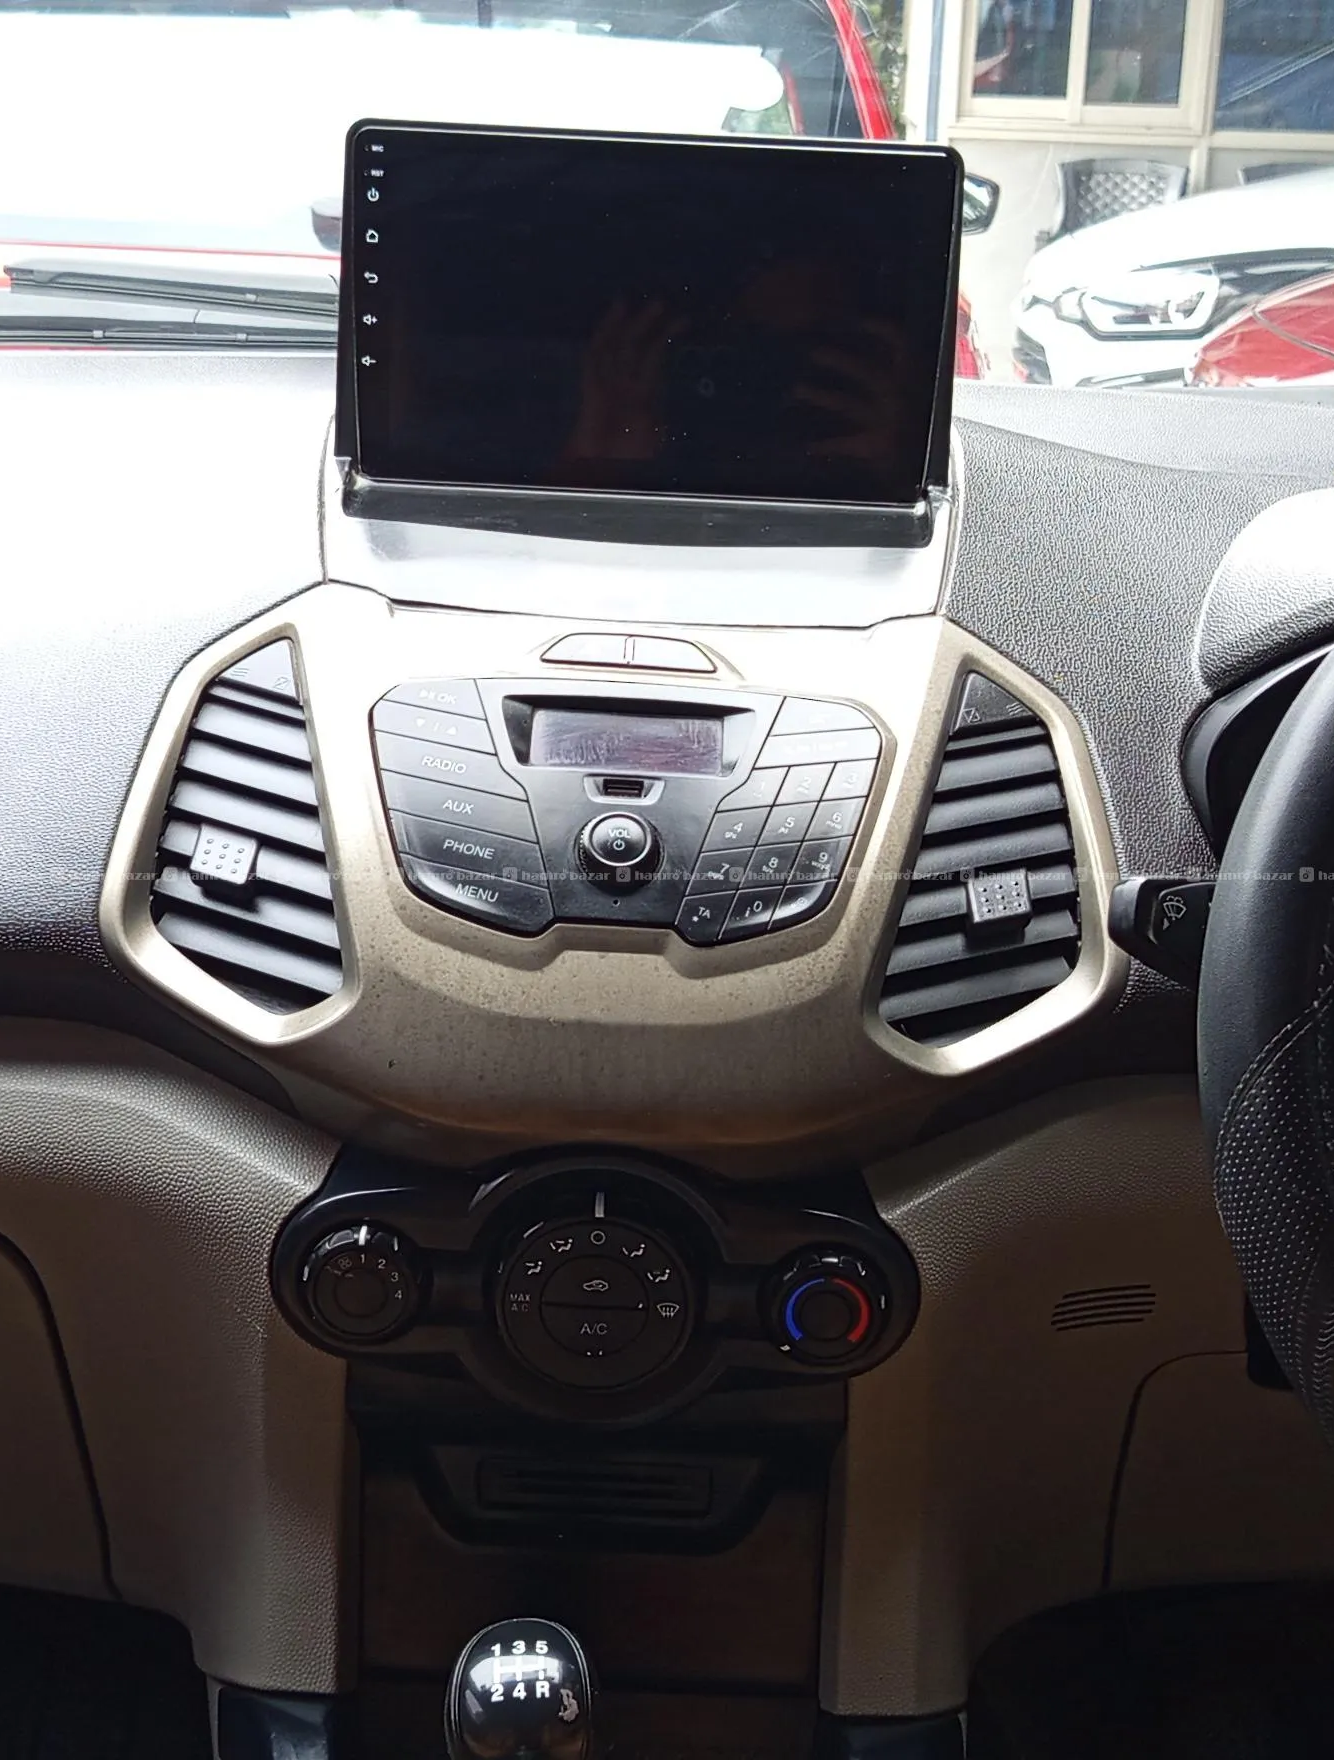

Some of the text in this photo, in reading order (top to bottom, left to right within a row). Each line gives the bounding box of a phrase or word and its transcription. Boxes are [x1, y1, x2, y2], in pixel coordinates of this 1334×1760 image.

[436, 691, 457, 705] OK
[421, 755, 467, 774] RADIO
[442, 799, 474, 815] AUX
[784, 816, 796, 828] 5
[832, 812, 842, 823] 6
[608, 829, 631, 839] VOL
[733, 822, 743, 834] 4
[443, 839, 496, 860] PHONE
[768, 857, 779, 869] 8
[818, 851, 828, 863] 9
[720, 862, 730, 874] 7
[454, 883, 499, 903] MENU
[699, 906, 711, 919] TA
[753, 900, 763, 913] 0
[359, 1254, 366, 1264] 1
[378, 1259, 386, 1269] 2
[391, 1272, 399, 1282] 3
[395, 1290, 402, 1300] 4
[509, 1293, 532, 1302] MAX
[579, 1322, 608, 1335] A/C
[490, 1640, 549, 1657] 1 3 5
[490, 1680, 550, 1703] 2 4 R
